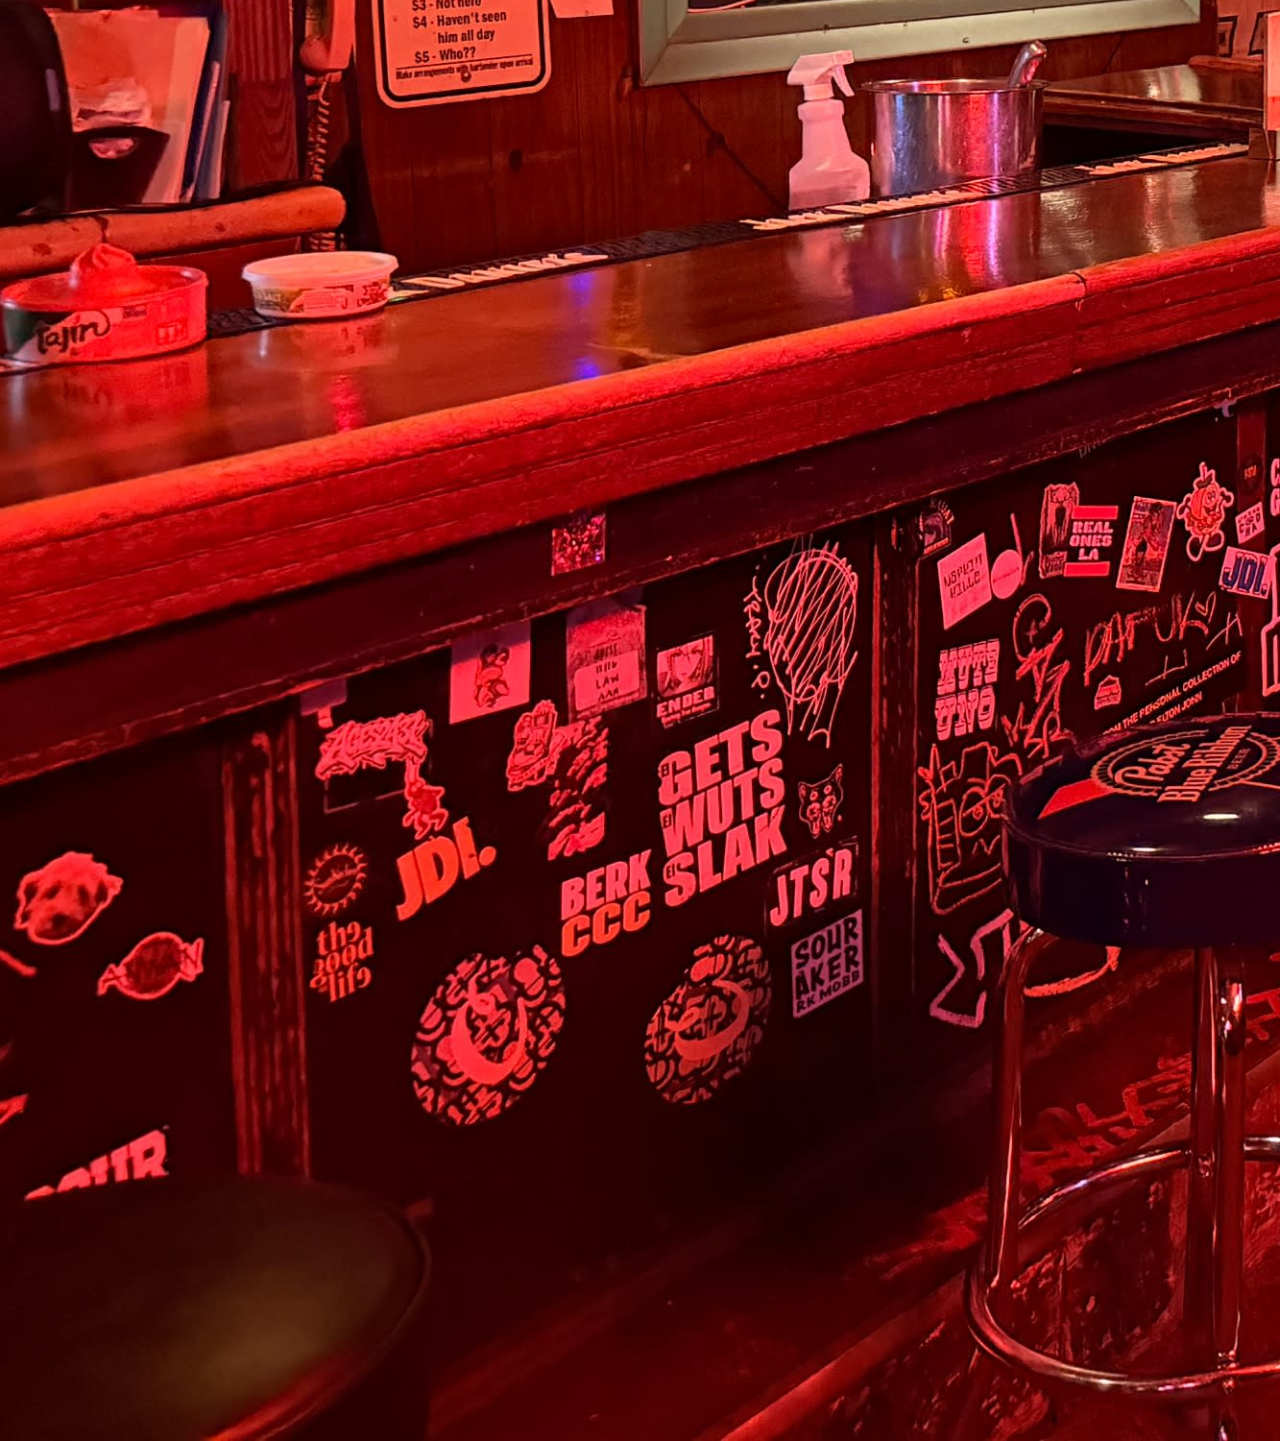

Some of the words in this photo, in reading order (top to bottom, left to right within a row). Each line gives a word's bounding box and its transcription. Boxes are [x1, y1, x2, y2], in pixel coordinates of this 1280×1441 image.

[412, 0, 426, 11] $3
[413, 16, 427, 29] $4
[437, 13, 479, 26] Haven't
[482, 12, 507, 22] seen
[415, 51, 430, 64] $5
[439, 47, 476, 60] Who??
[438, 32, 458, 44] him
[461, 30, 474, 42] all
[477, 29, 495, 41] day
[1069, 535, 1112, 548] ONES
[1072, 521, 1114, 534] REAL
[1078, 548, 1099, 560] LA
[1123, 715, 1139, 730] THE
[1139, 687, 1181, 719] PERSONAL
[1183, 659, 1230, 692] COLLECTION
[1231, 650, 1243, 665] OF
[658, 709, 783, 806] GETS
[1114, 742, 1191, 789] Pabst
[660, 758, 785, 857] WUTS
[1156, 768, 1218, 803] Blue
[663, 806, 787, 907] SLAK
[561, 850, 652, 922] BERK
[560, 889, 650, 958] CCC
[795, 915, 859, 970] SOUR
[795, 945, 860, 997] AKER
